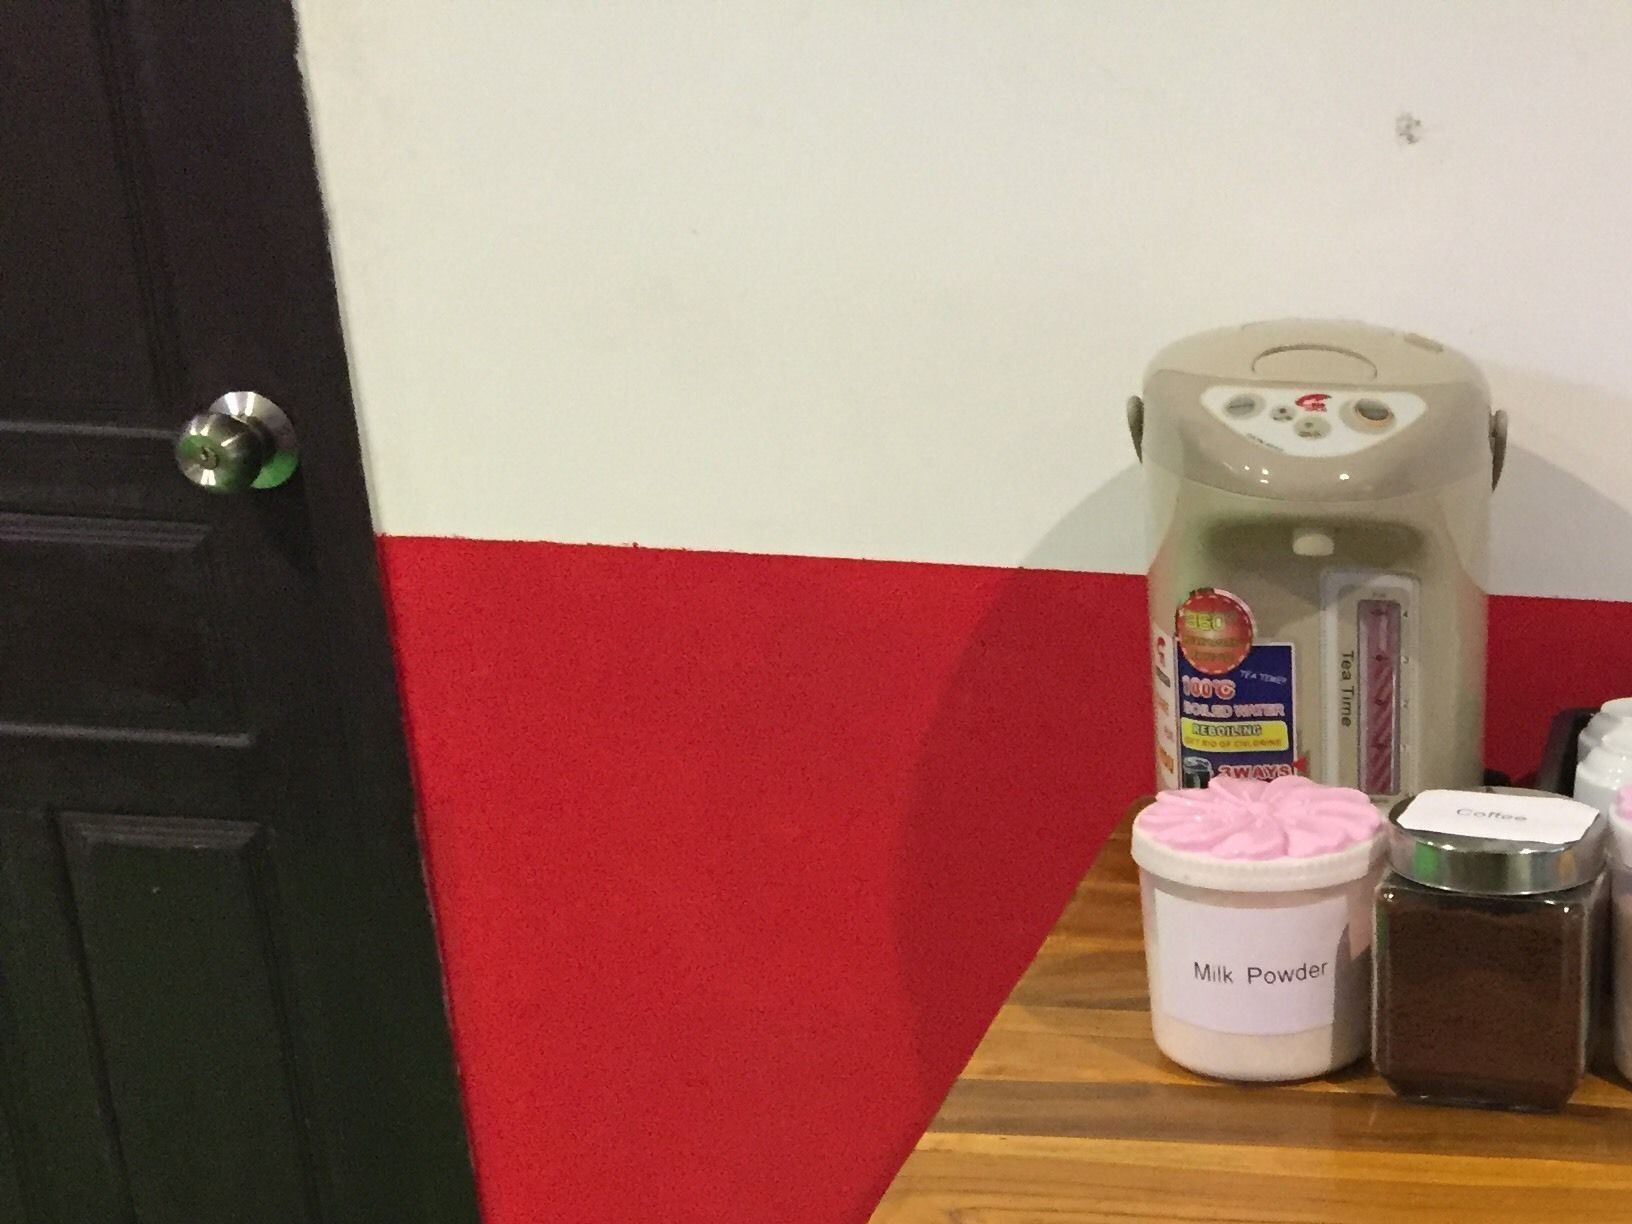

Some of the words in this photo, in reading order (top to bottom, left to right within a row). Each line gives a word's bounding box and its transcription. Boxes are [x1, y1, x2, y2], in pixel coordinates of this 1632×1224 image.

[1340, 650, 1355, 681] Tea
[1340, 686, 1355, 728] Time
[1192, 723, 1263, 737] REBOILING
[1456, 807, 1528, 821] Coffee
[1193, 961, 1234, 984] Milk
[1247, 962, 1329, 985] Powder
